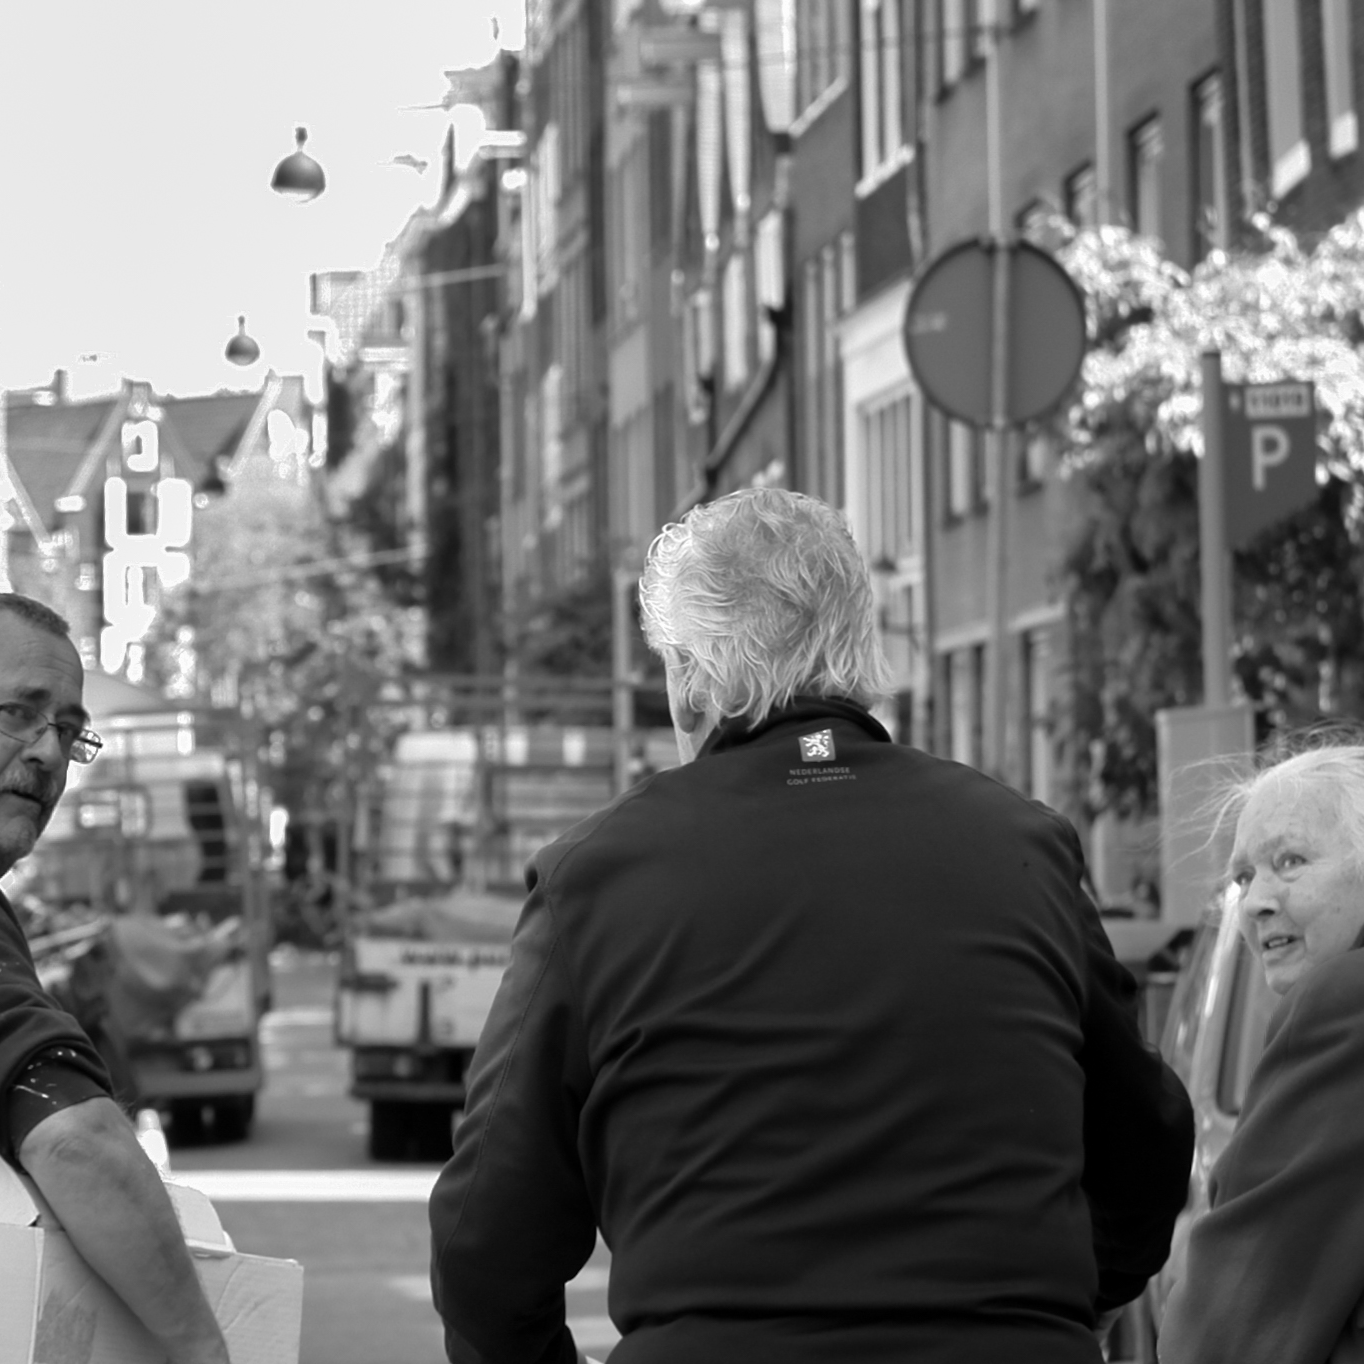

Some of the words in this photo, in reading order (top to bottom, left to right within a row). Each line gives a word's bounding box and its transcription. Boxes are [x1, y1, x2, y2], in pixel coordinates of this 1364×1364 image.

[1251, 423, 1291, 492] P
[788, 766, 851, 776] NEDERLANDSE
[786, 777, 809, 786] GOLF
